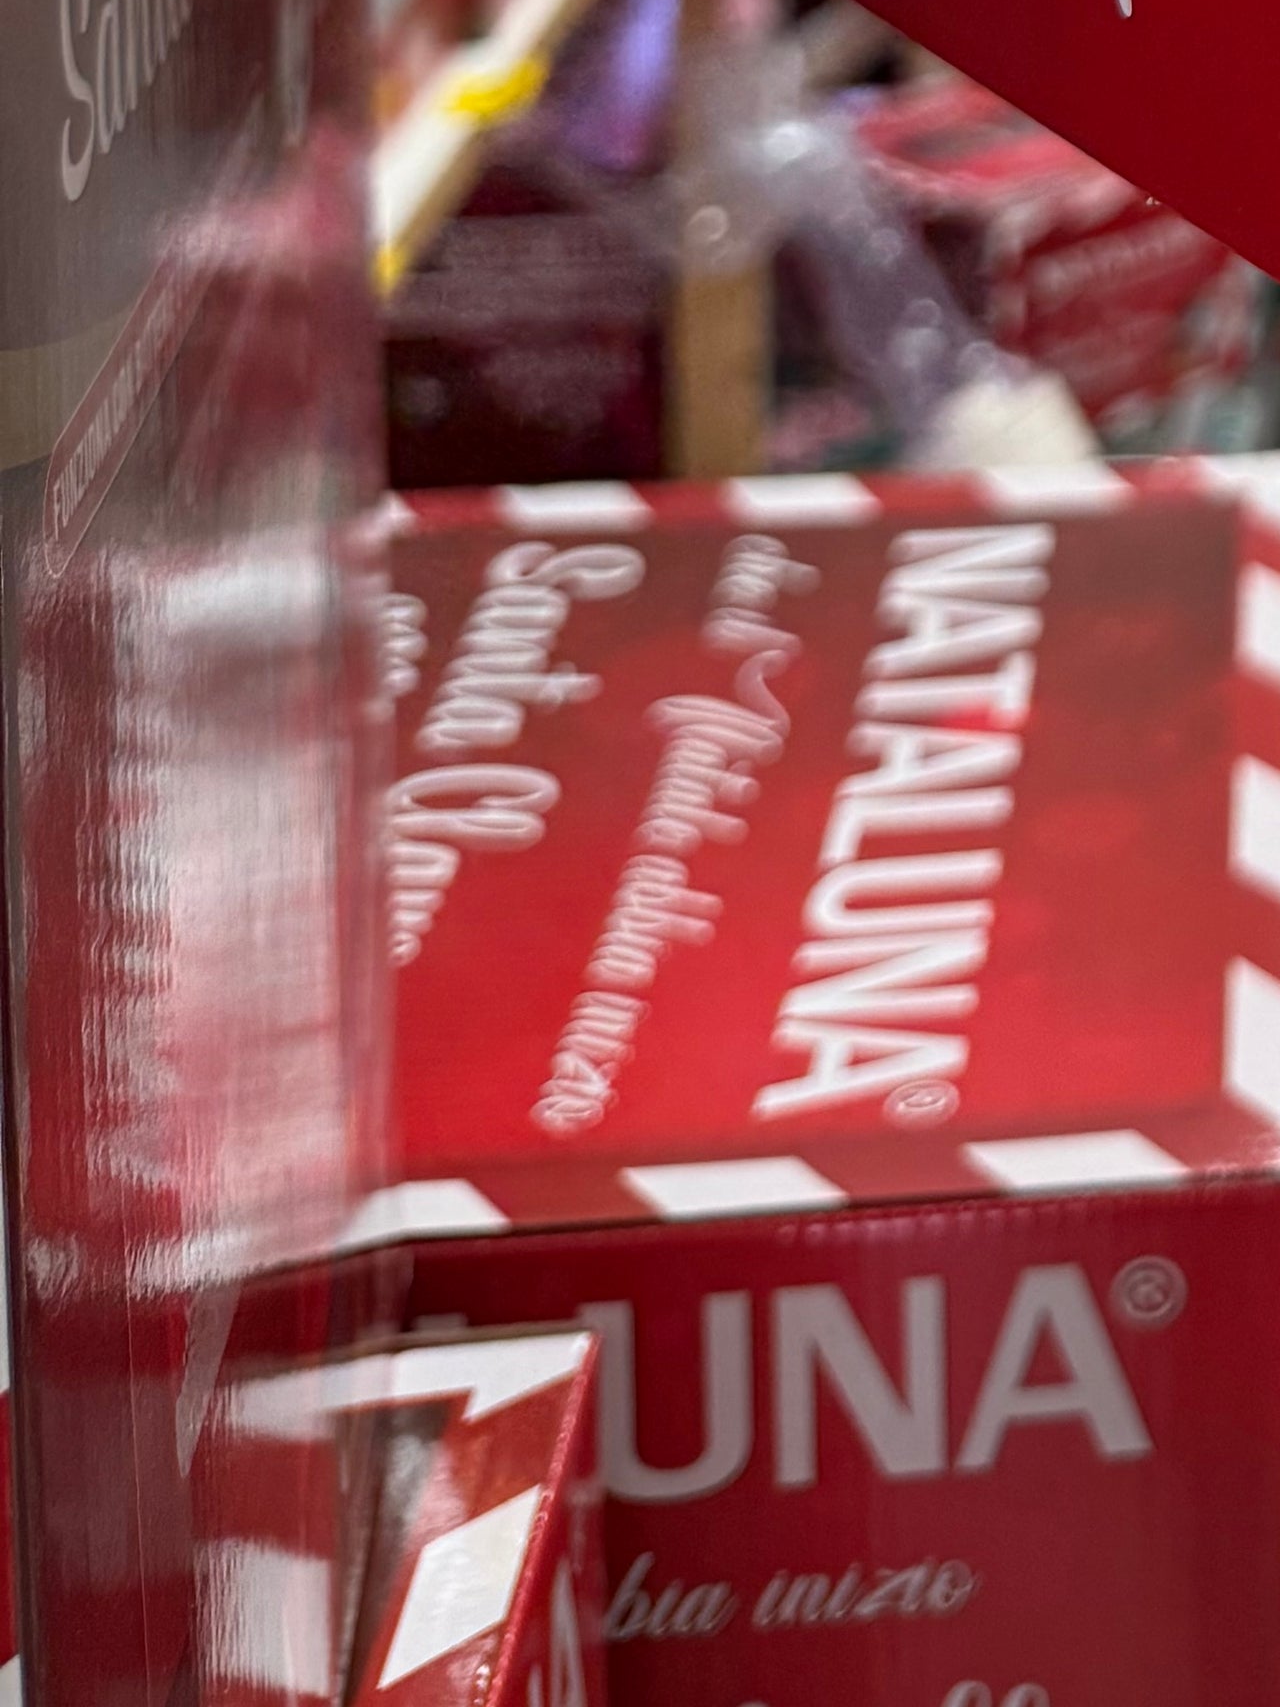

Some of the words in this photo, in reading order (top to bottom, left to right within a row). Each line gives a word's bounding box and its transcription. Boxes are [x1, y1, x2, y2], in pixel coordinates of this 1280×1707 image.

[53, 395, 111, 542] FUNZIONA
[414, 541, 647, 752] Santa
[752, 1557, 976, 1629] inizio
